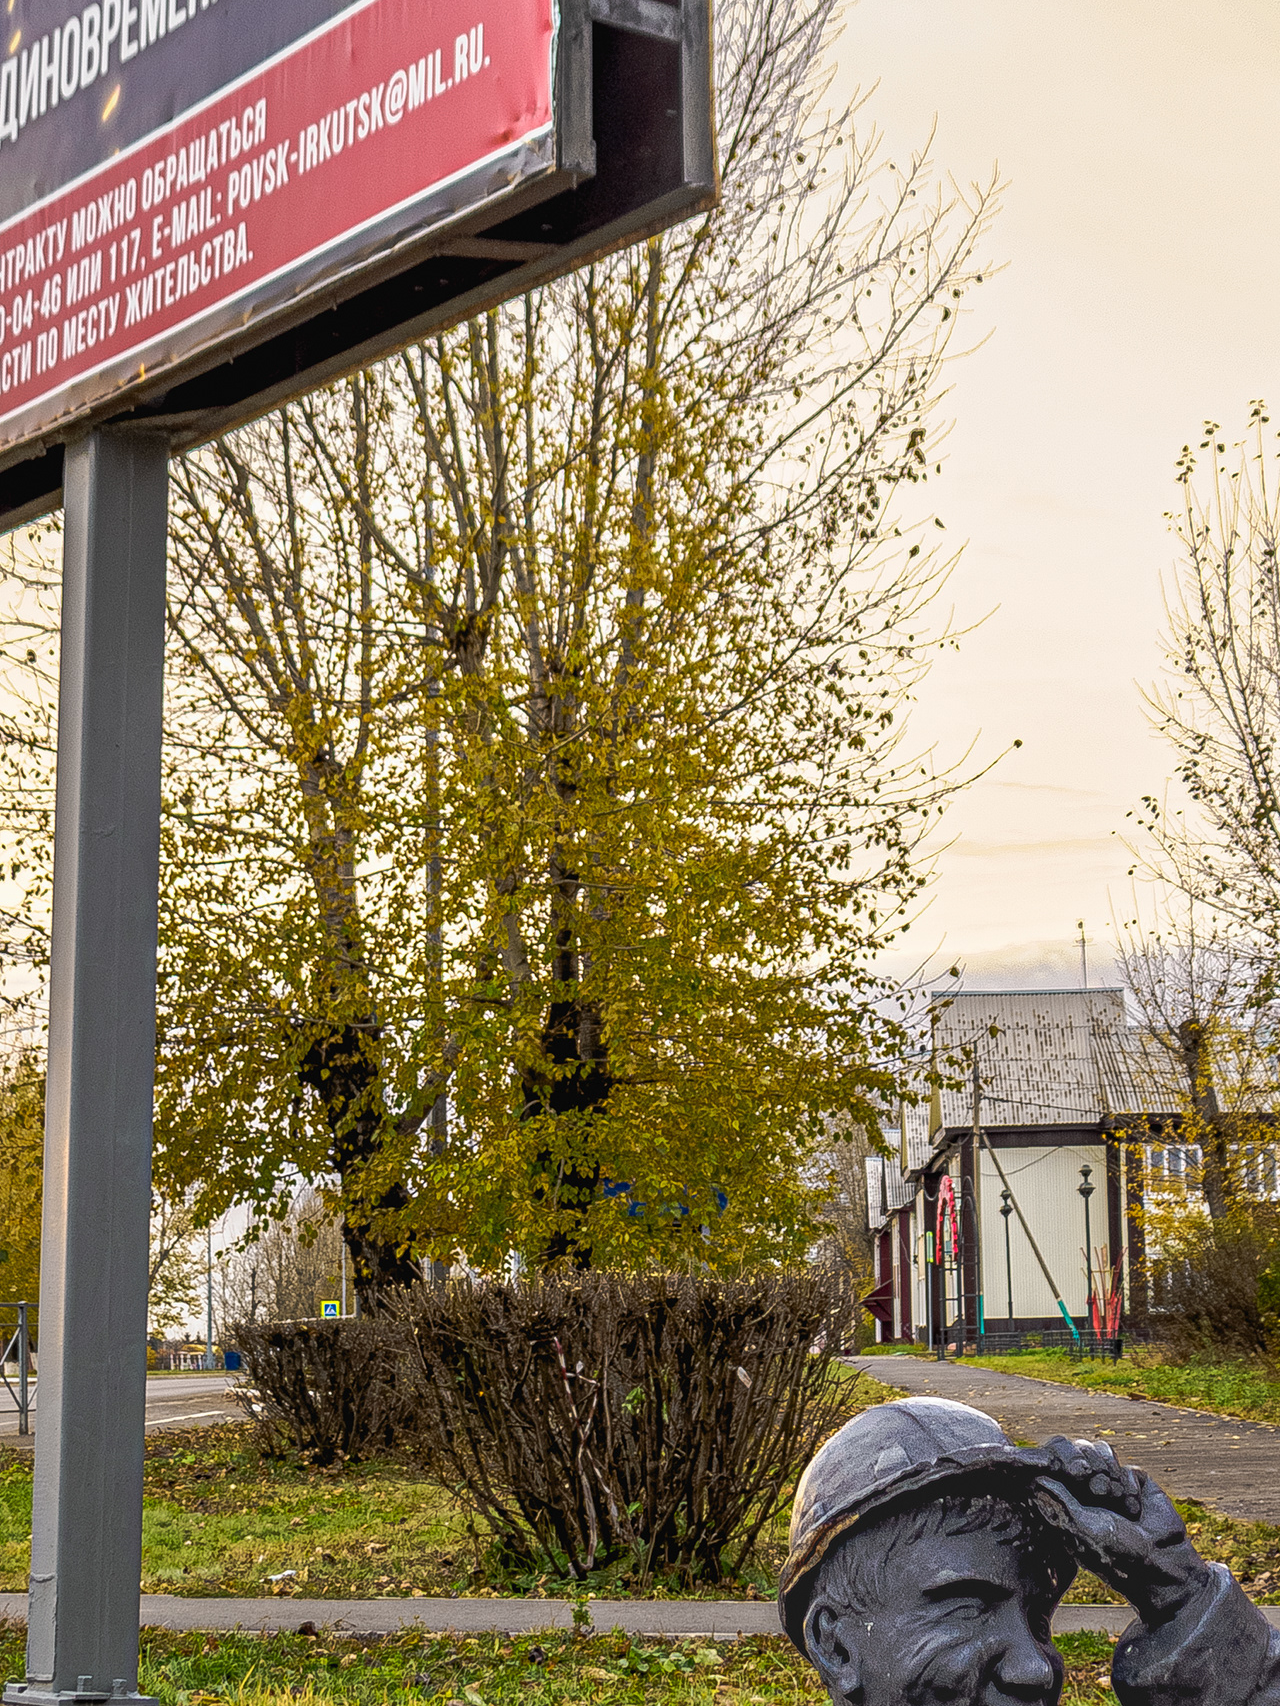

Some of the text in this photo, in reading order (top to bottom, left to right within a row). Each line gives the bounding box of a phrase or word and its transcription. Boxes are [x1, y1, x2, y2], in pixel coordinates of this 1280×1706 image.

[66, 249, 102, 308] ИЛИ
[109, 227, 146, 283] 117,
[152, 185, 222, 260] E-MAIL:
[227, 22, 490, 216] POVSK-IRKUTSK@MIL.RU.
[72, 177, 137, 253] МОЖНО
[141, 97, 267, 212] ОБРАЩАТЬСЯ
[37, 326, 58, 376] ПО
[62, 291, 120, 362] МЕСТУ
[124, 221, 254, 329] ЖИТЕЛЬСТВА.
